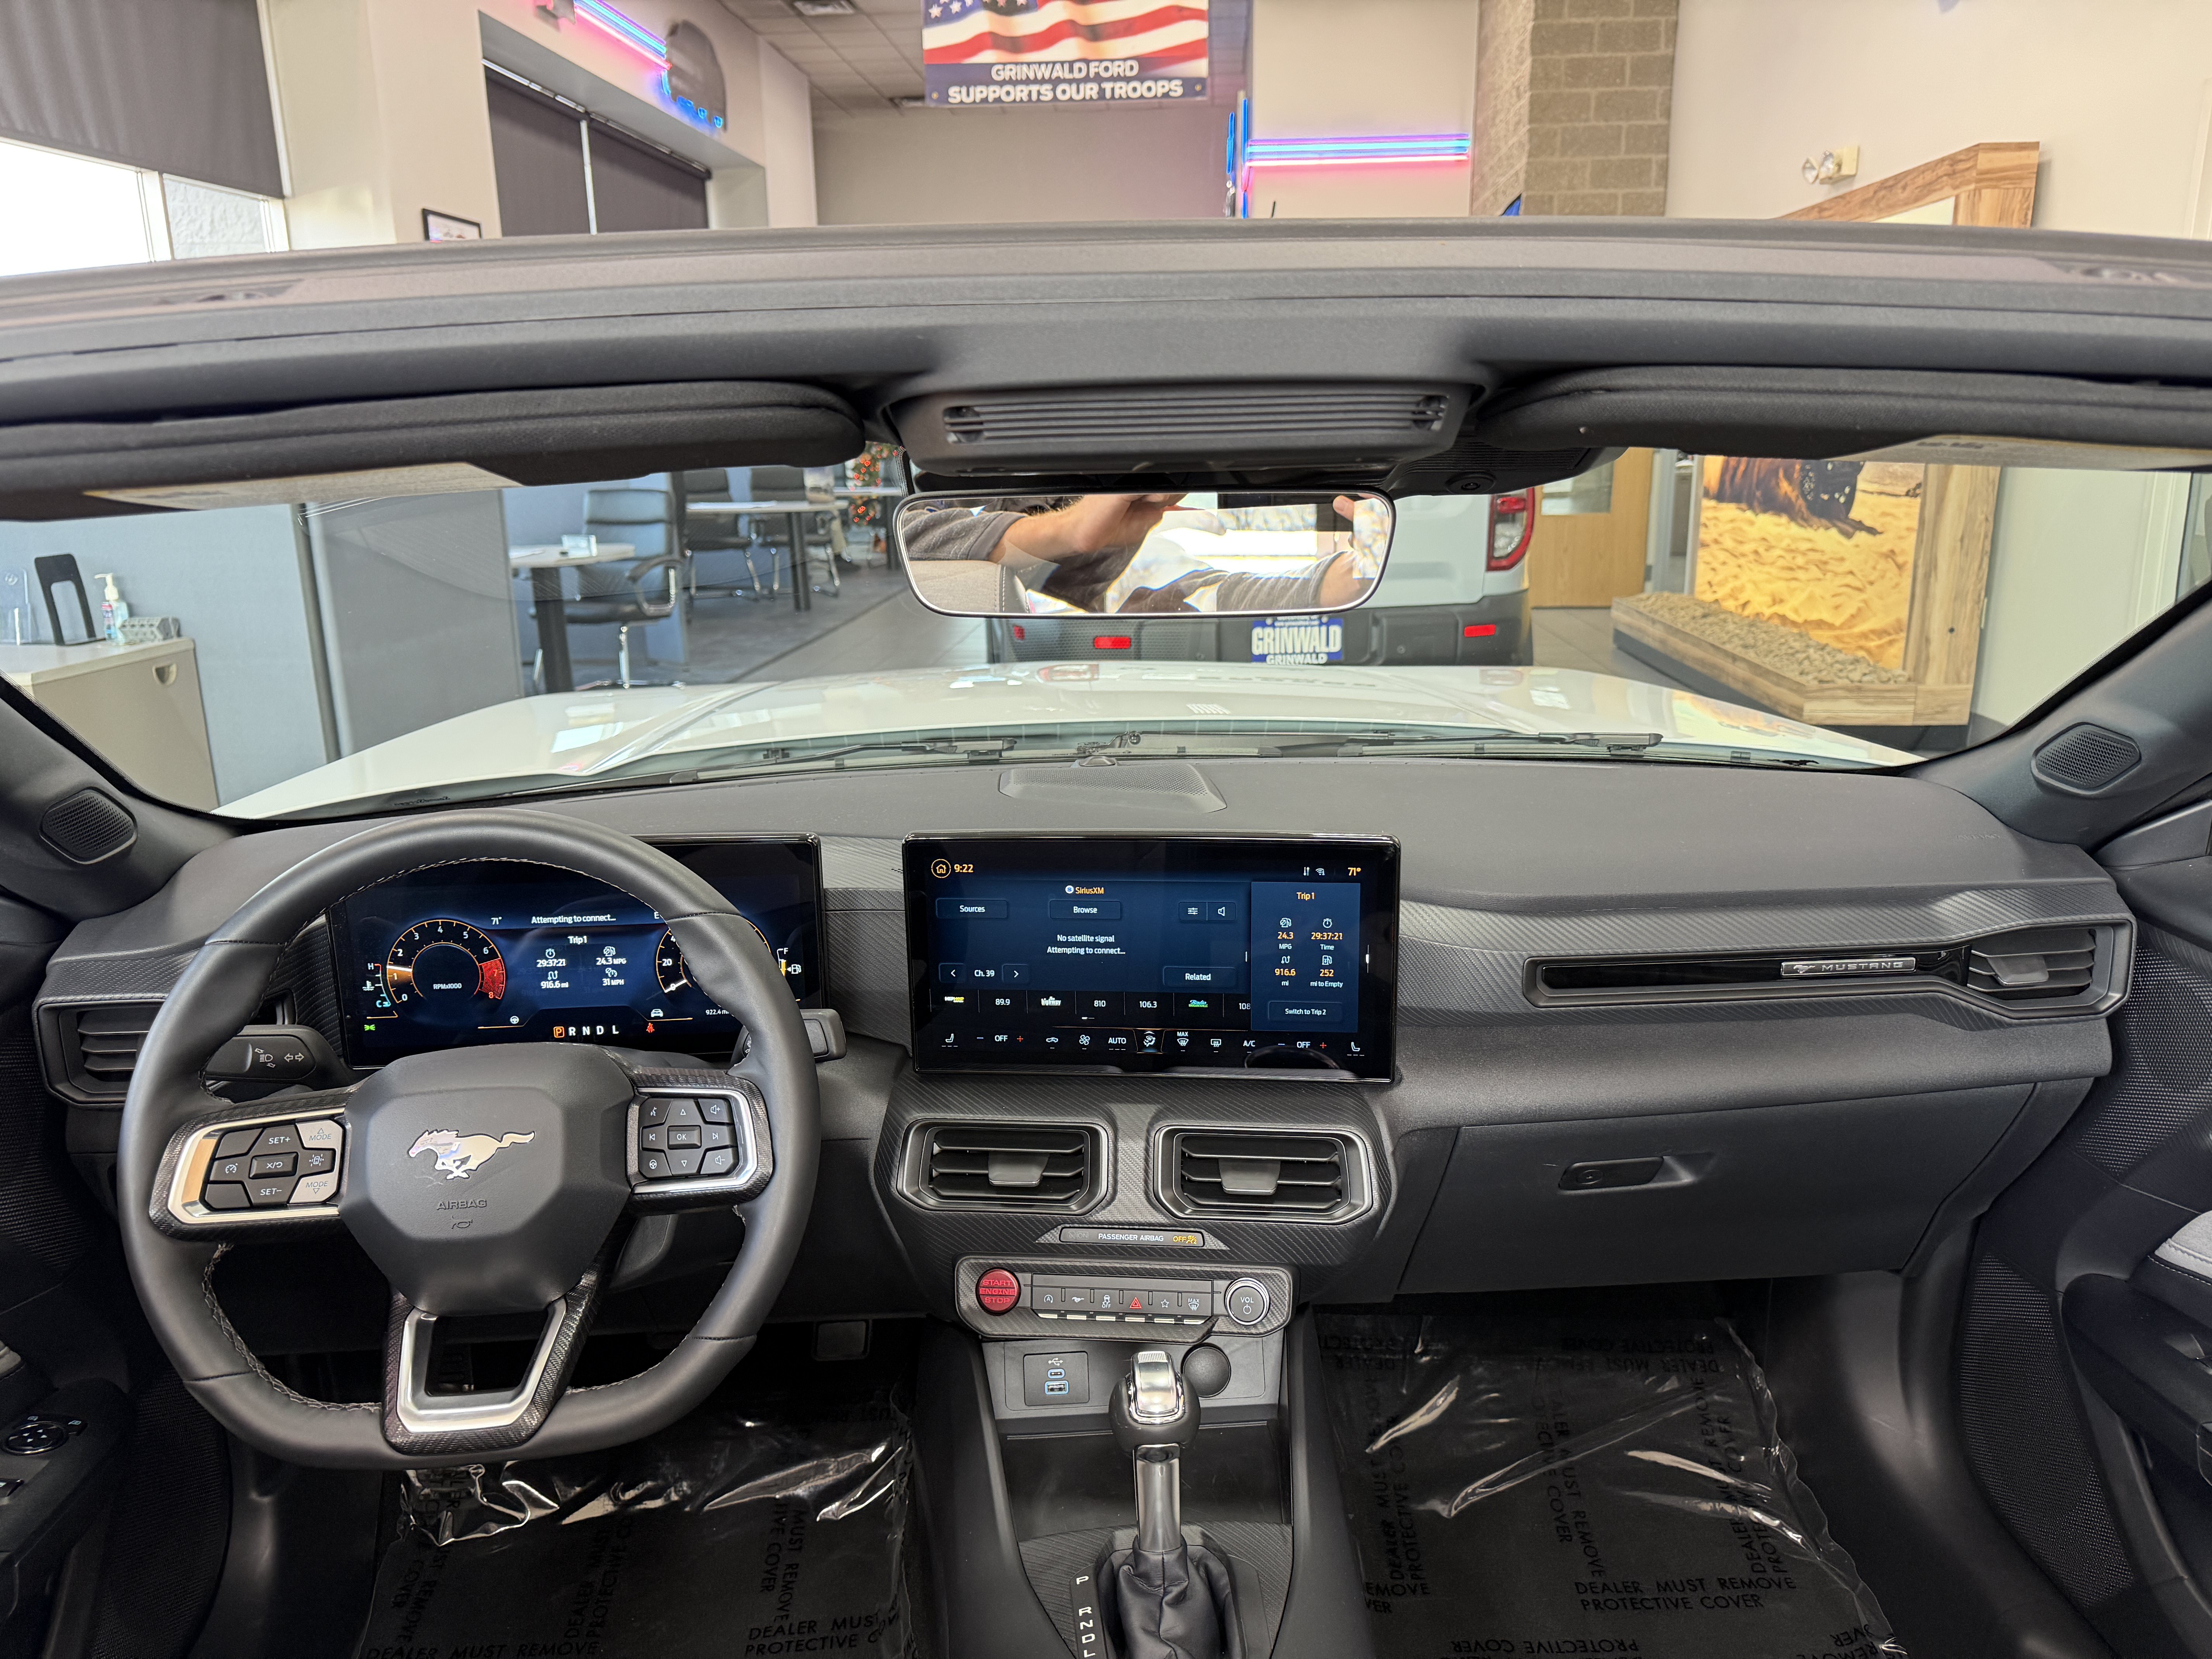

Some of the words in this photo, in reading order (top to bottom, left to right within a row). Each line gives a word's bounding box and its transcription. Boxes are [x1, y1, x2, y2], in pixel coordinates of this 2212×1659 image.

[991, 62, 1087, 81] GRINWALD
[1089, 60, 1139, 77] FORD
[948, 84, 1054, 103] SUPPORTS
[1056, 82, 1099, 101] OUR
[1101, 79, 1184, 100] TROOPS
[1252, 625, 1342, 655] GRINWALD
[1266, 653, 1328, 665] GRINWALD
[954, 864, 974, 873] 9:22
[1348, 867, 1361, 876] 71°
[1297, 892, 1311, 901] Trip
[959, 905, 985, 913] Sources
[491, 917, 502, 925] 71°
[531, 916, 573, 925] Attempting
[567, 936, 582, 945] Trip
[1095, 935, 1115, 943] signal
[1311, 932, 1343, 940] 29:37:21
[397, 949, 404, 957] 2
[1047, 946, 1085, 955] Attempting
[536, 958, 566, 967] 29:37:21
[1821, 962, 1903, 972] MUSTANG
[1185, 973, 1211, 981] Related
[568, 1027, 576, 1036] R
[582, 1026, 590, 1036] N
[596, 1026, 604, 1035] D
[612, 1025, 620, 1034] L
[436, 1199, 487, 1210] AIRBAG
[1547, 1486, 1573, 1543] COVER
[788, 1511, 807, 1553] MUST
[1394, 1482, 1426, 1580] PROTECTIVE
[1572, 1510, 1606, 1577] REMOVE
[1381, 1519, 1405, 1580] DEALER
[760, 1542, 782, 1593] COVER
[1076, 1575, 1089, 1585] P
[1574, 1580, 1644, 1594] DEALER
[1656, 1578, 1707, 1593] MUST
[1716, 1577, 1797, 1590] REMOVE
[773, 1563, 799, 1622] REMOVE
[1364, 1581, 1431, 1596] EMOVE
[1364, 1598, 1393, 1614] VER
[1580, 1597, 1693, 1611] PROTECTIVE
[1700, 1593, 1765, 1609] COVER
[1078, 1606, 1092, 1616] R
[748, 1620, 817, 1640] DEALER
[1080, 1619, 1093, 1630] N
[1081, 1633, 1096, 1644] D
[451, 1644, 508, 1659] MUST
[517, 1641, 599, 1658] REMOVE
[744, 1633, 859, 1656] PROTECTIVE
[1450, 1639, 1515, 1654] COVER
[1523, 1638, 1640, 1654] PROTECTIVE
[1084, 1649, 1096, 1658] L
